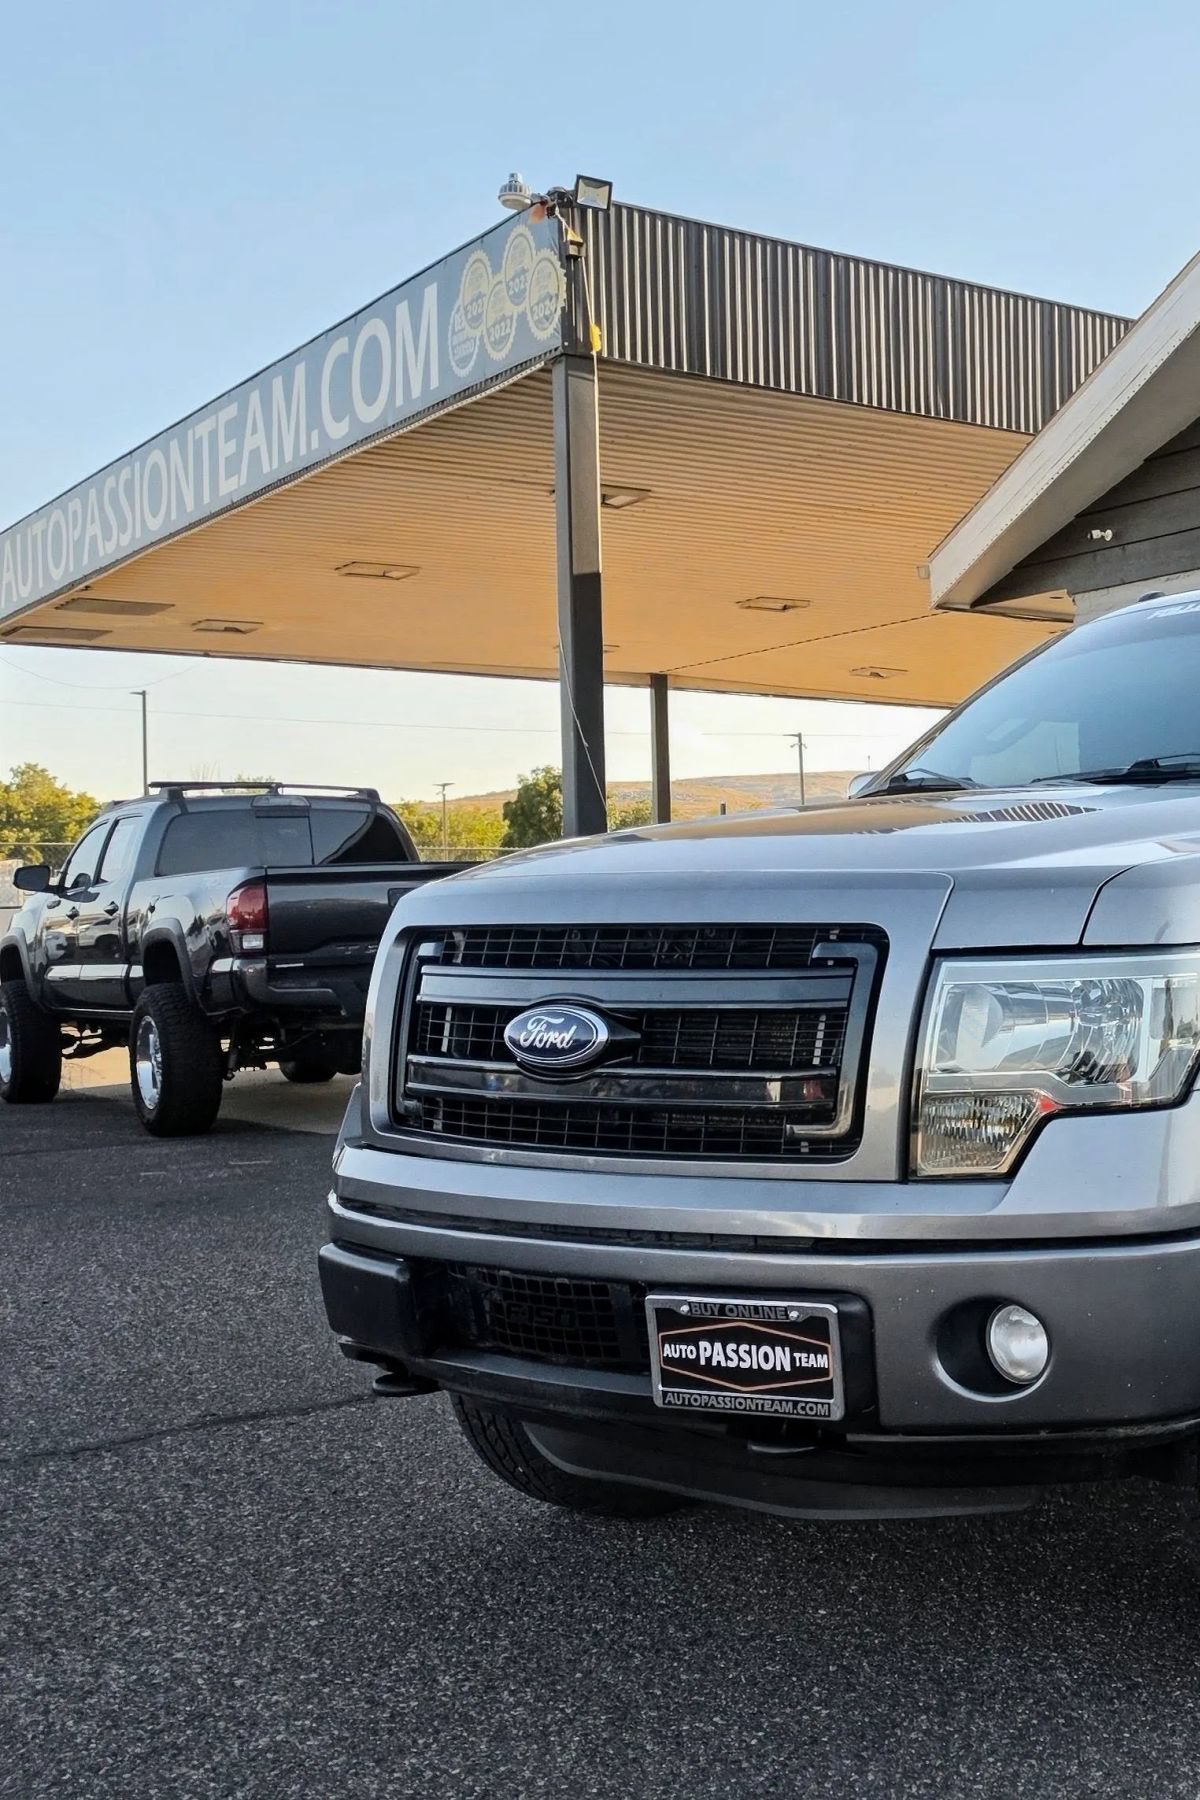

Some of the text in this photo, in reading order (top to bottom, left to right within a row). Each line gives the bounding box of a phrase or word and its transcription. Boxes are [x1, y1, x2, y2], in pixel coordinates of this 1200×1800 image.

[0, 282, 440, 609] AUTOPASSIONTEAM.COM
[519, 1015, 577, 1049] Ford
[690, 1302, 787, 1320] BUY ONLINE
[663, 1340, 829, 1372] AUTO PASSION TEAM
[664, 1393, 830, 1417] AUTOPASSIONTEAM.COM
